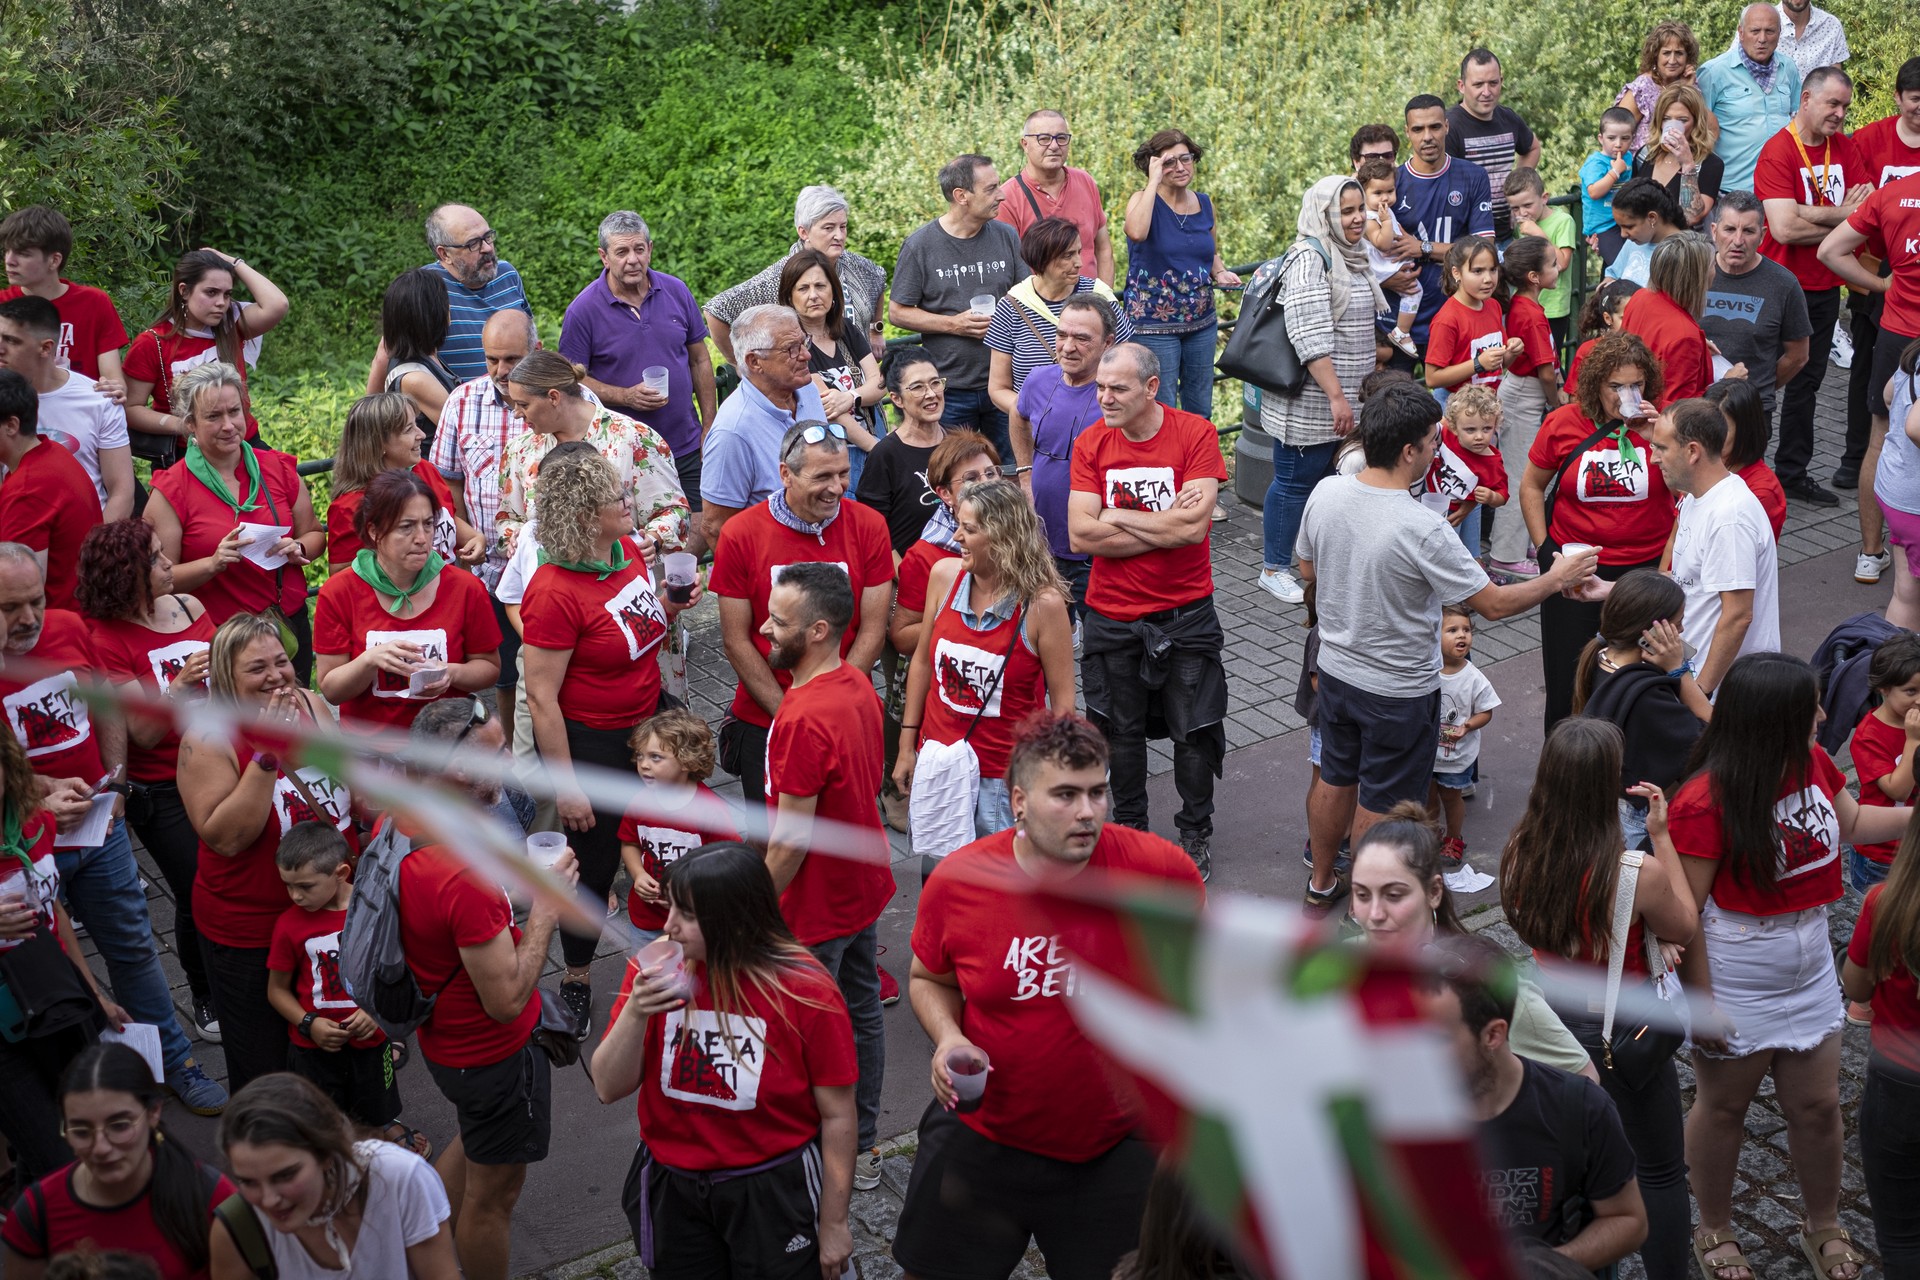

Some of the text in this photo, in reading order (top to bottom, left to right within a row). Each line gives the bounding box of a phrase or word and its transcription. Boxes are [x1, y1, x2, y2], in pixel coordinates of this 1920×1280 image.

[1582, 459, 1643, 478] ARETA
[1110, 479, 1171, 500] ARETA
[1592, 477, 1635, 494] BETI
[616, 589, 659, 630] ARETA
[939, 651, 997, 689] ARETA
[281, 775, 346, 817] ARTA
[1779, 801, 1834, 834] RETA
[641, 836, 691, 864] ARET
[1003, 935, 1066, 972] ARE
[670, 1022, 756, 1064] ARETA
[680, 1062, 737, 1090] BETI
